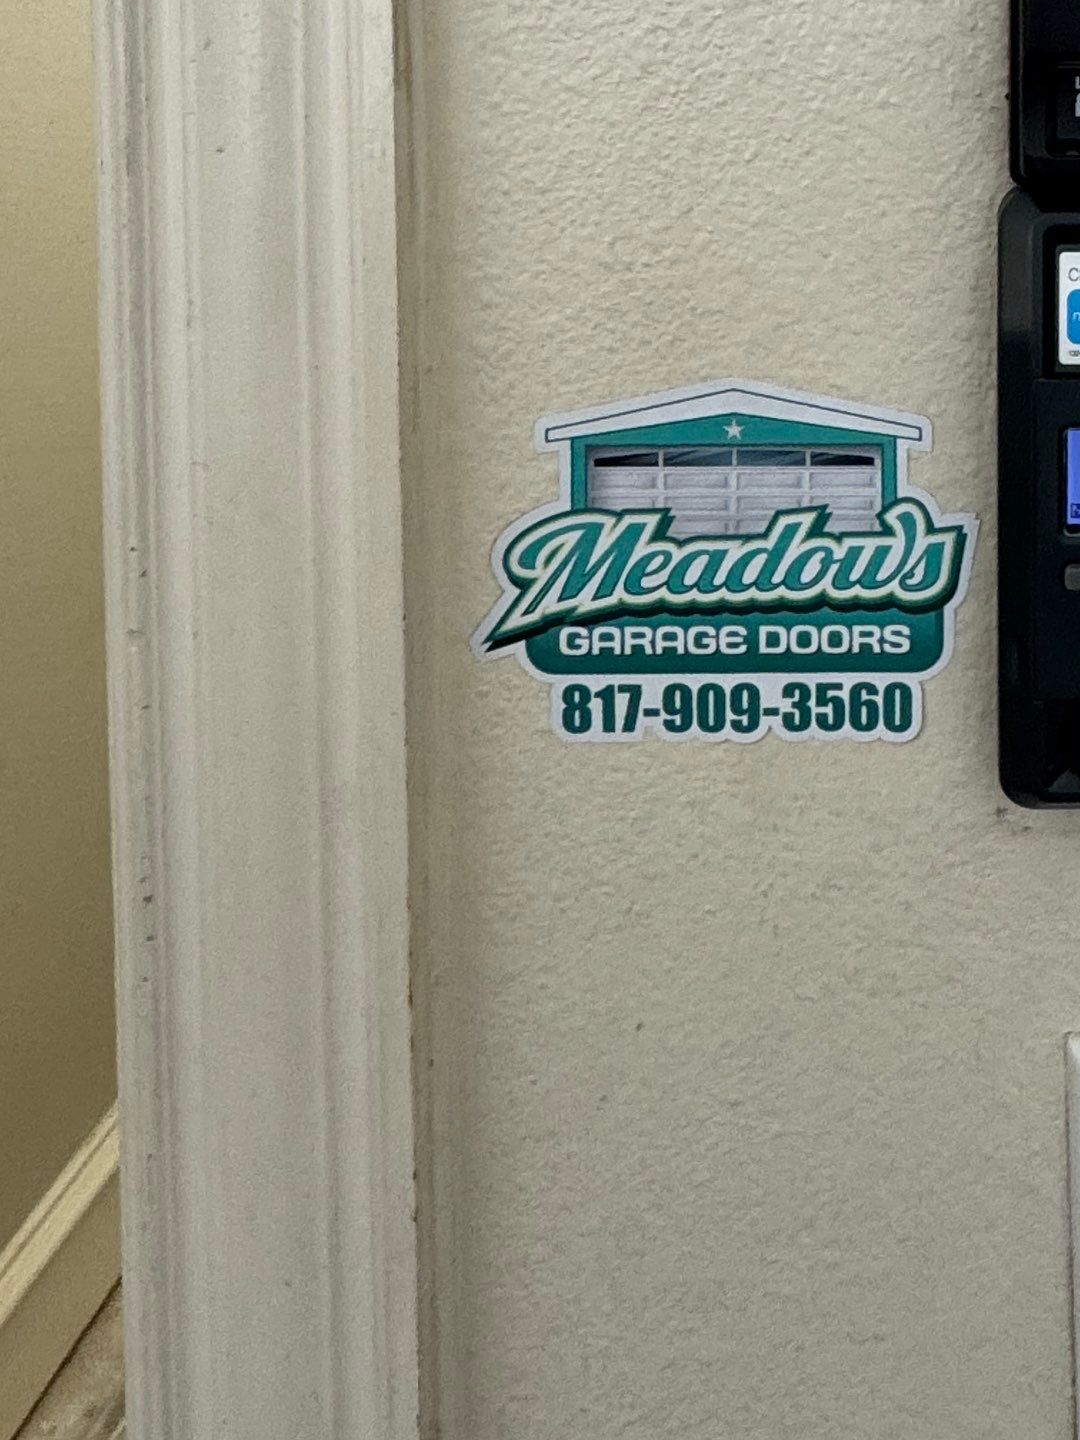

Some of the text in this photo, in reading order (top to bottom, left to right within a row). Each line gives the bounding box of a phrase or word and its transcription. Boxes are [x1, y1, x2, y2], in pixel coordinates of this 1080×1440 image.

[557, 624, 912, 658] GARAGE DOORS
[560, 681, 914, 734] 817-909-3560
